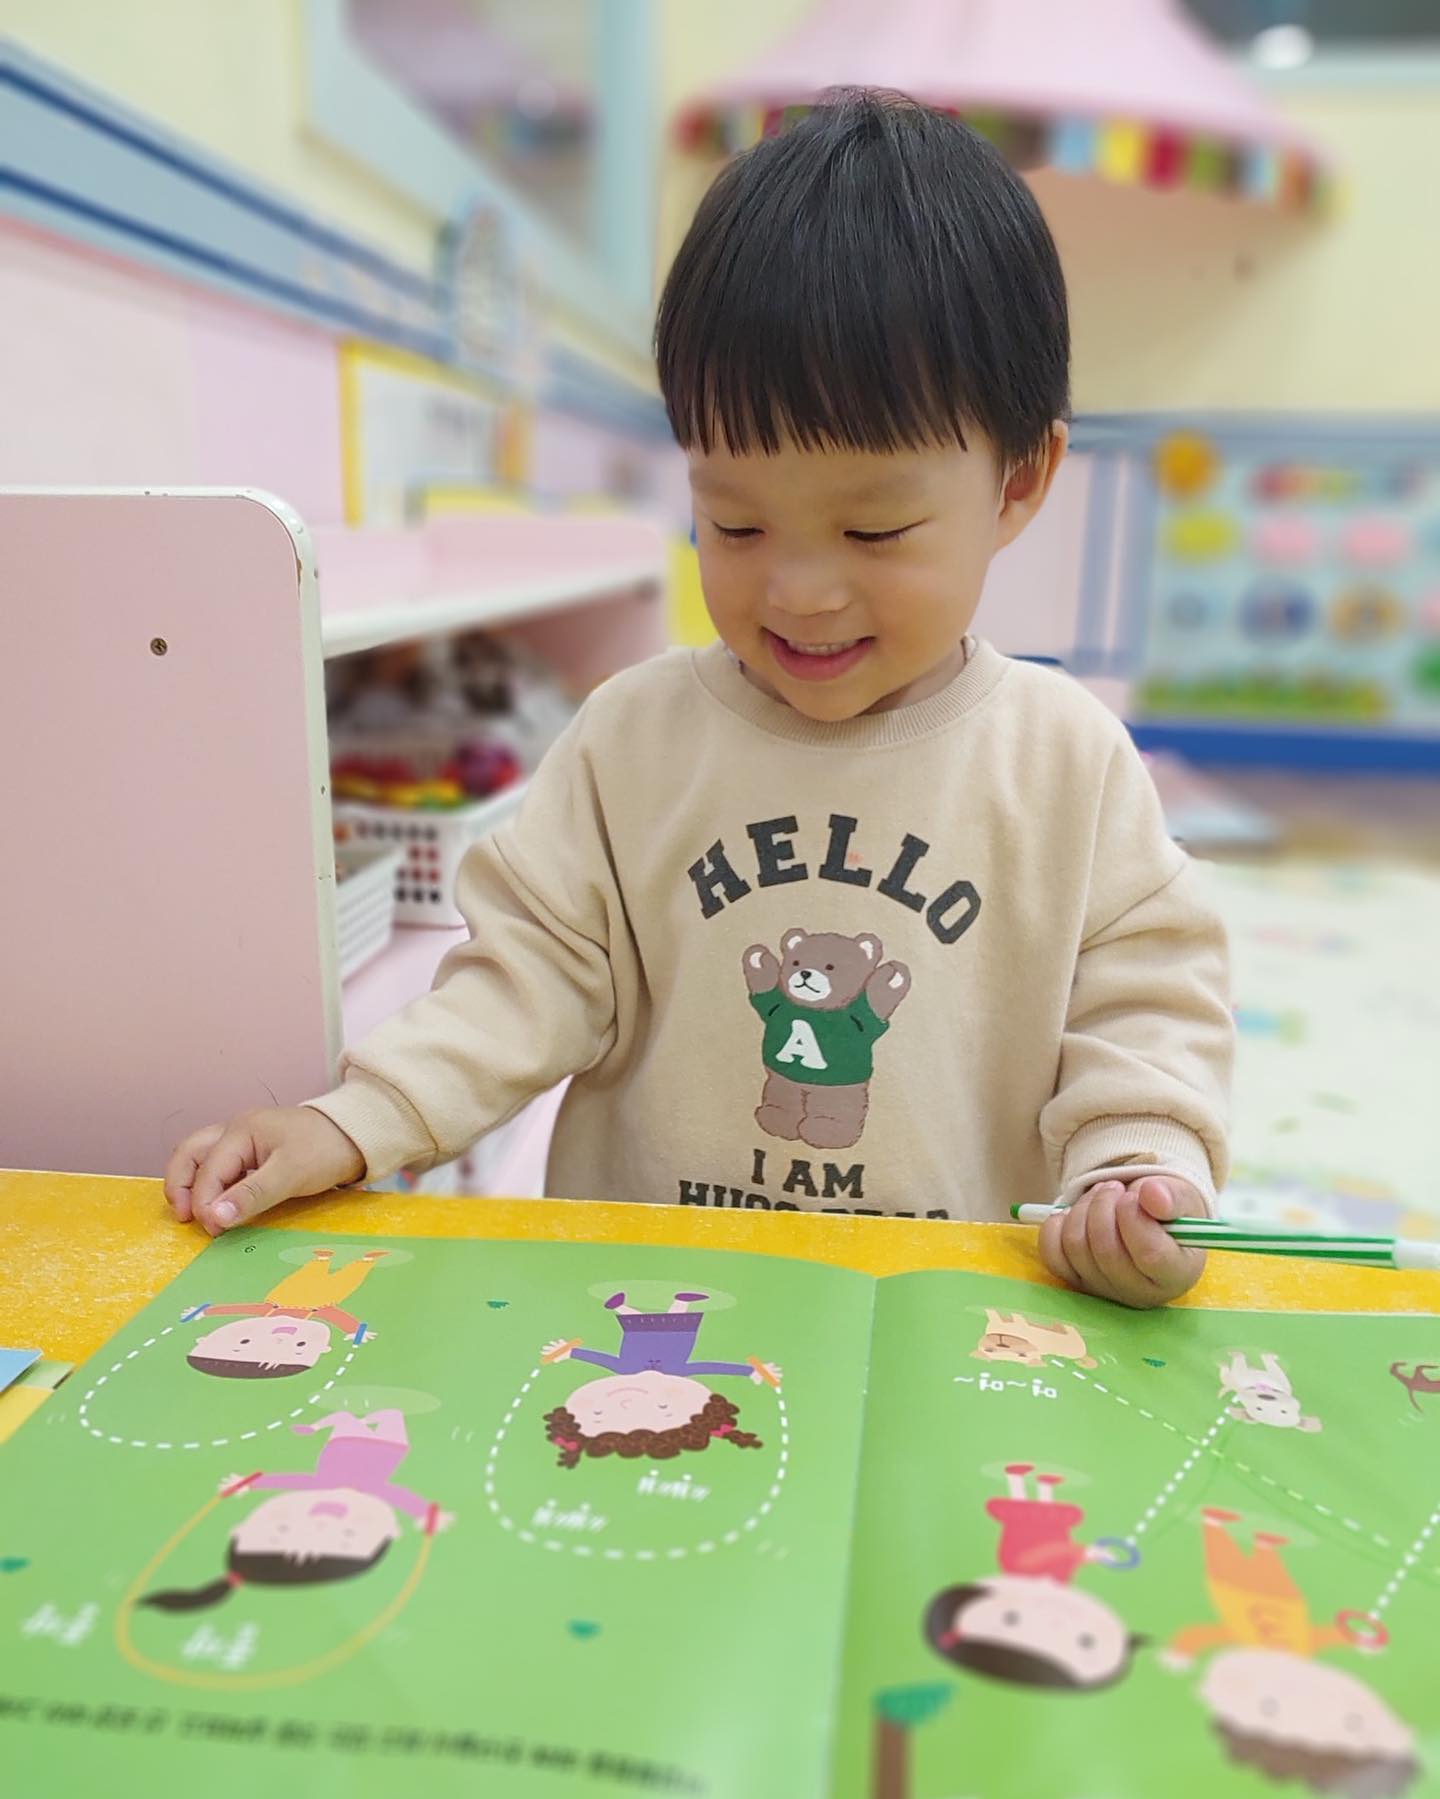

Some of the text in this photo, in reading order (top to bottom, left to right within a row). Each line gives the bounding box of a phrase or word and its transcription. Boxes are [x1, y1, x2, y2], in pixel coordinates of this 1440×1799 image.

[687, 814, 982, 945] HELLO
[775, 1019, 828, 1070] A
[751, 1148, 865, 1199] I AM
